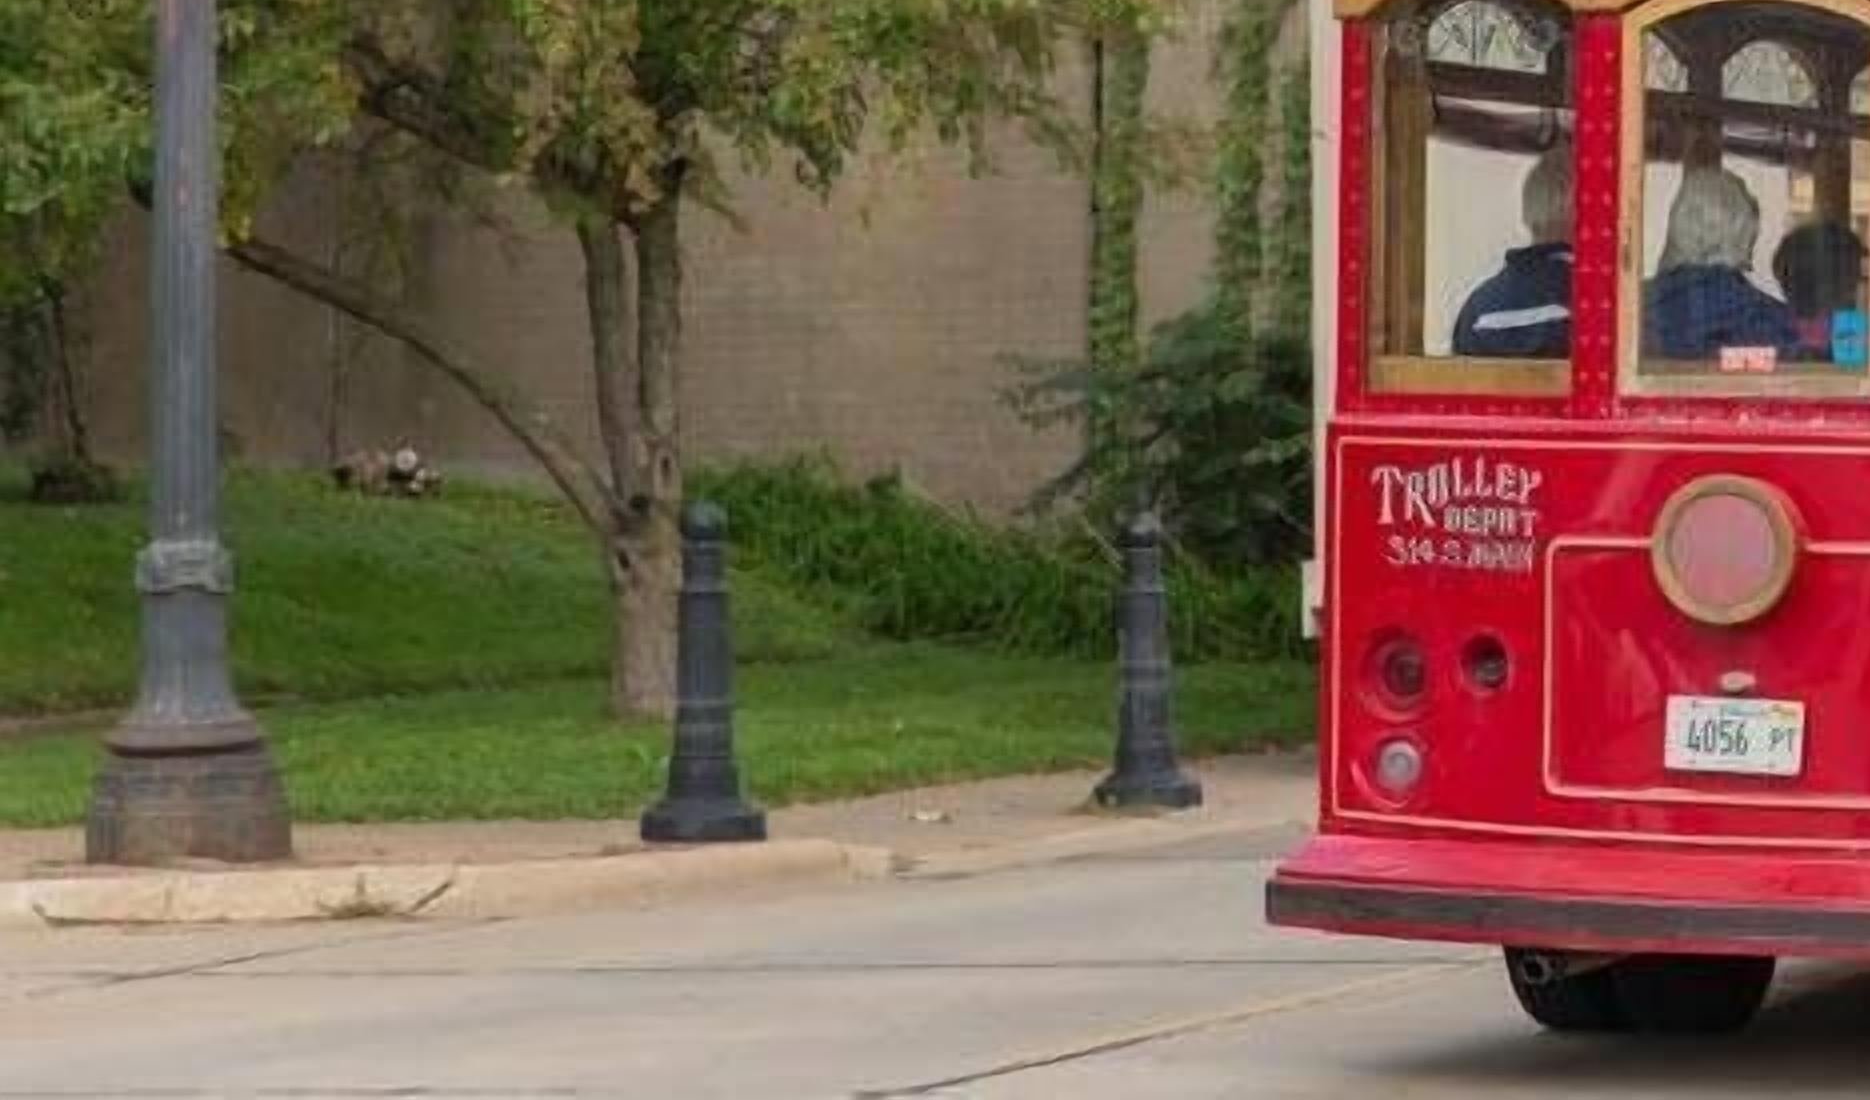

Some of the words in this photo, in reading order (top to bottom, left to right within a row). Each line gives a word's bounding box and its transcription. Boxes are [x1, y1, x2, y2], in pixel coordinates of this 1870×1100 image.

[1371, 456, 1543, 528] TROLLEY
[1443, 505, 1538, 537] DEPOT
[1686, 718, 1748, 755] 4056
[1769, 726, 1795, 753] PT
